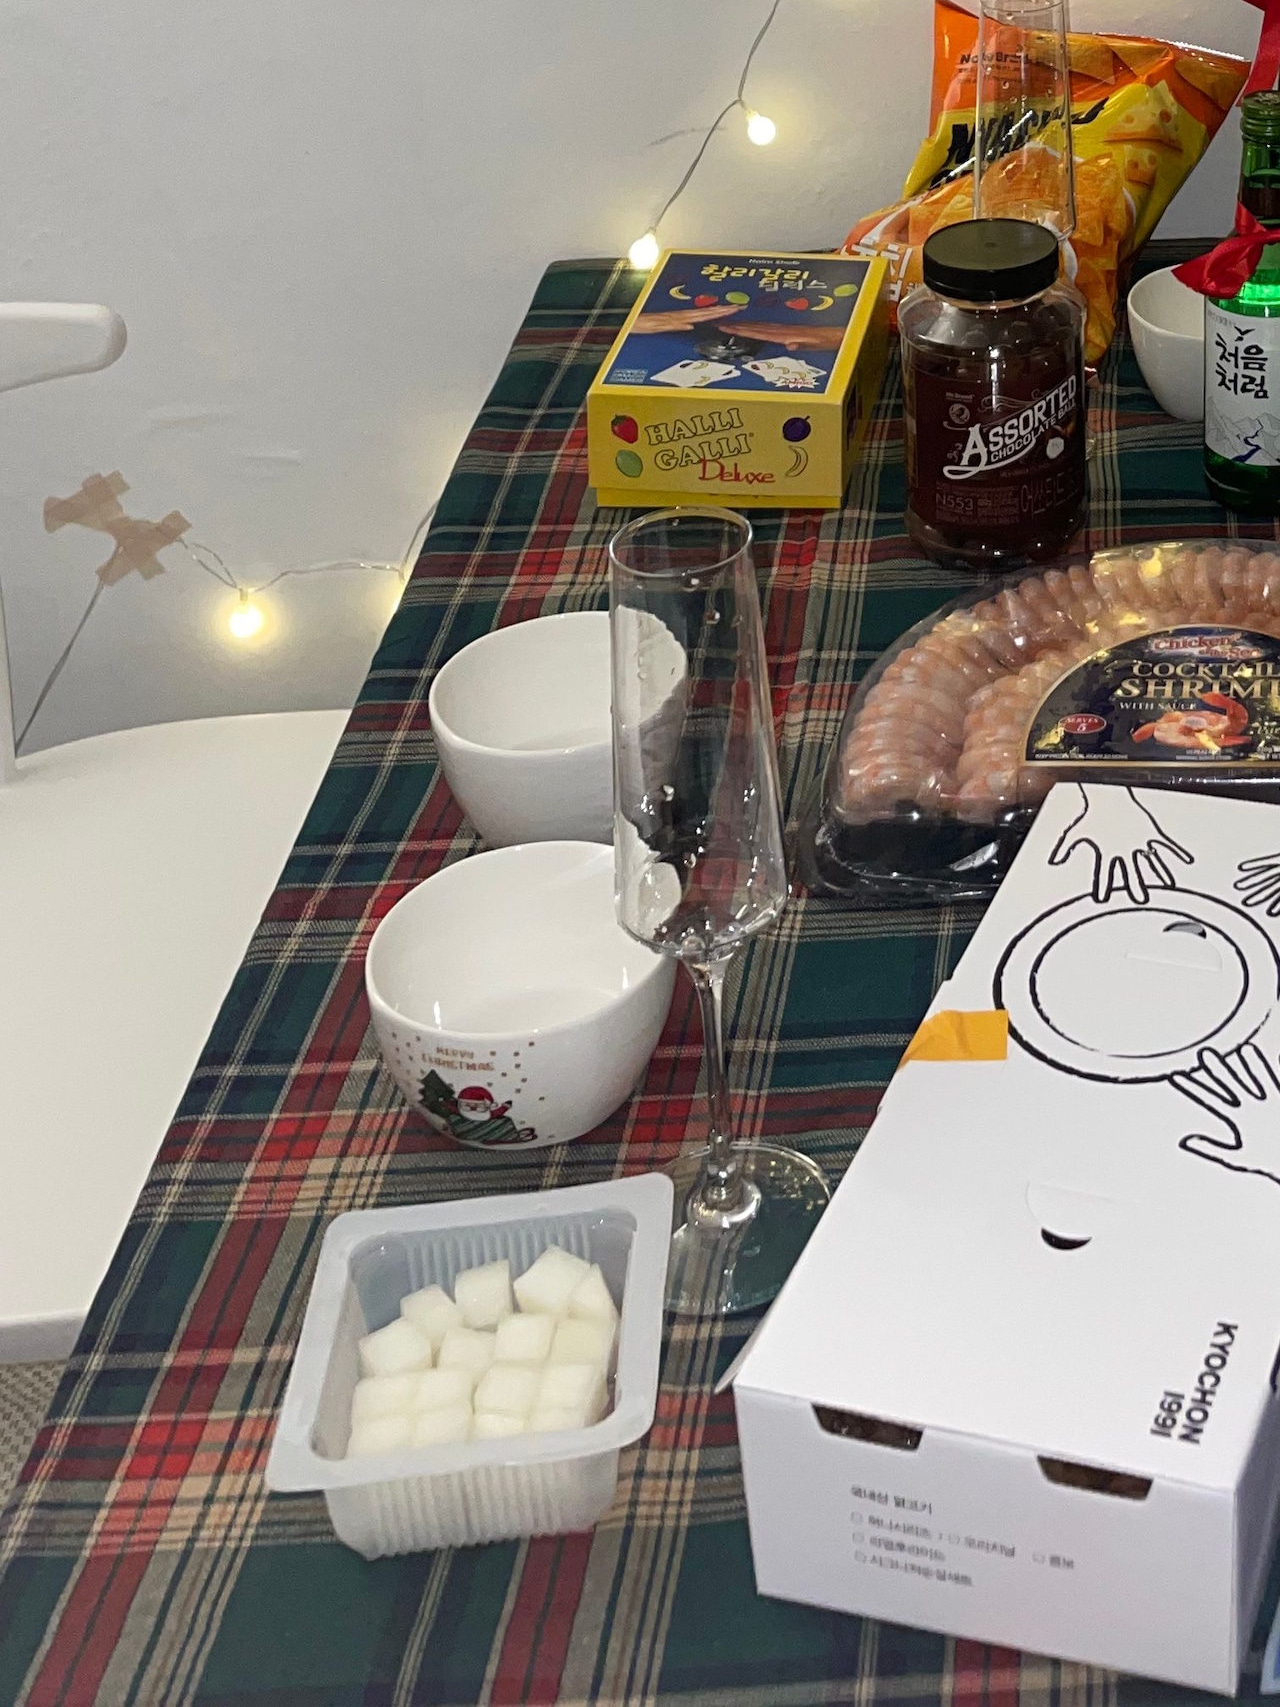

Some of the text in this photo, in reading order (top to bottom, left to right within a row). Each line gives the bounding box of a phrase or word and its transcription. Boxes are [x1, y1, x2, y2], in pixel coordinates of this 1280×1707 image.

[700, 264, 810, 282] 할리갈리
[1215, 333, 1268, 372] 처음
[1215, 362, 1269, 399] 처럼
[644, 407, 744, 446] HALLI
[948, 375, 1077, 477] ASSORTED
[1057, 400, 1077, 419] BALL
[654, 433, 752, 471] GALLI
[990, 413, 1057, 462] CHOCOLATE
[698, 458, 776, 484] Deluxe
[1153, 635, 1231, 651] Chicken
[1119, 701, 1197, 710] WITH SAUCE
[1177, 1321, 1239, 1445] KYOCHON
[1149, 1390, 1185, 1438] 1991
